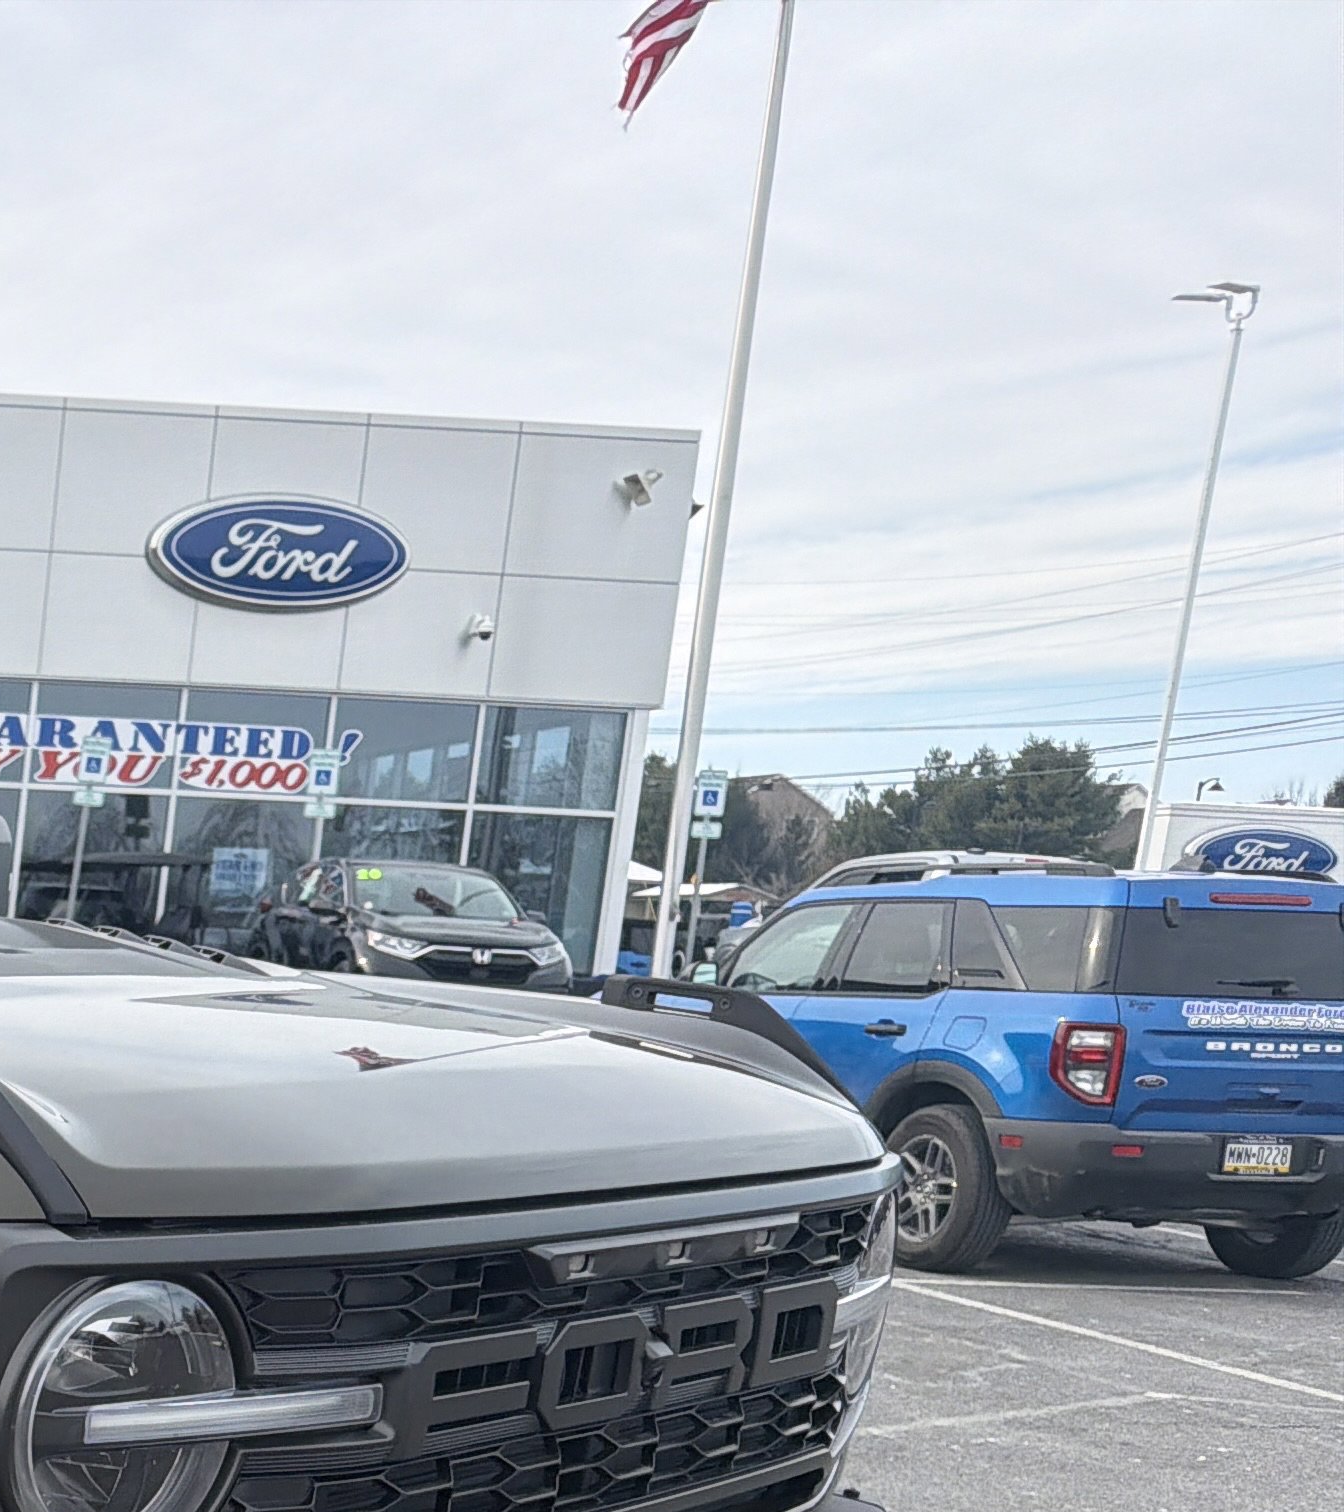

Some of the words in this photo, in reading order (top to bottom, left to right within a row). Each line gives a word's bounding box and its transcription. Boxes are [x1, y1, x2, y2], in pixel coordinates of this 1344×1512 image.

[211, 517, 359, 584] Ford
[180, 756, 308, 790] $1,000
[1223, 838, 1310, 872] Ford
[1186, 1003, 1237, 1016] Blaise
[1238, 1004, 1316, 1018] Alexander
[1206, 1041, 1343, 1053] BRONCO
[1250, 1052, 1300, 1060] SPORT
[387, 1276, 840, 1462] FORD
